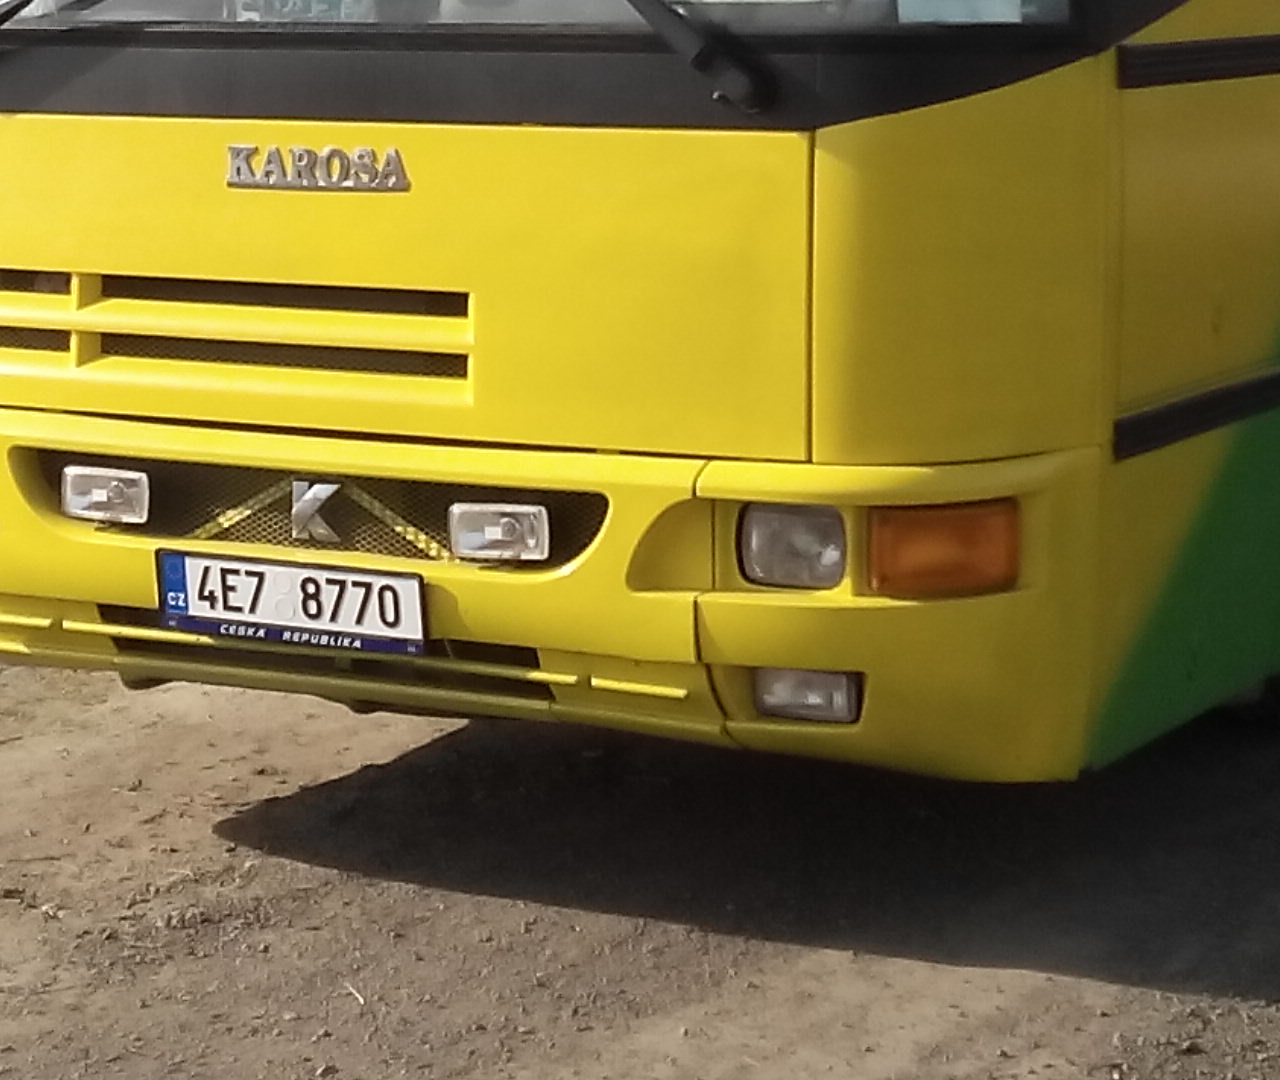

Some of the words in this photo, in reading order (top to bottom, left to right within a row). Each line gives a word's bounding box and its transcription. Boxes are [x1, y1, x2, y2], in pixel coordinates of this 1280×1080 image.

[226, 146, 412, 192] KAROSA
[292, 480, 342, 543] K
[167, 591, 187, 607] CZ
[196, 565, 266, 615] 4E7
[299, 575, 401, 629] 8770
[281, 630, 363, 650] REPUBLIKA
